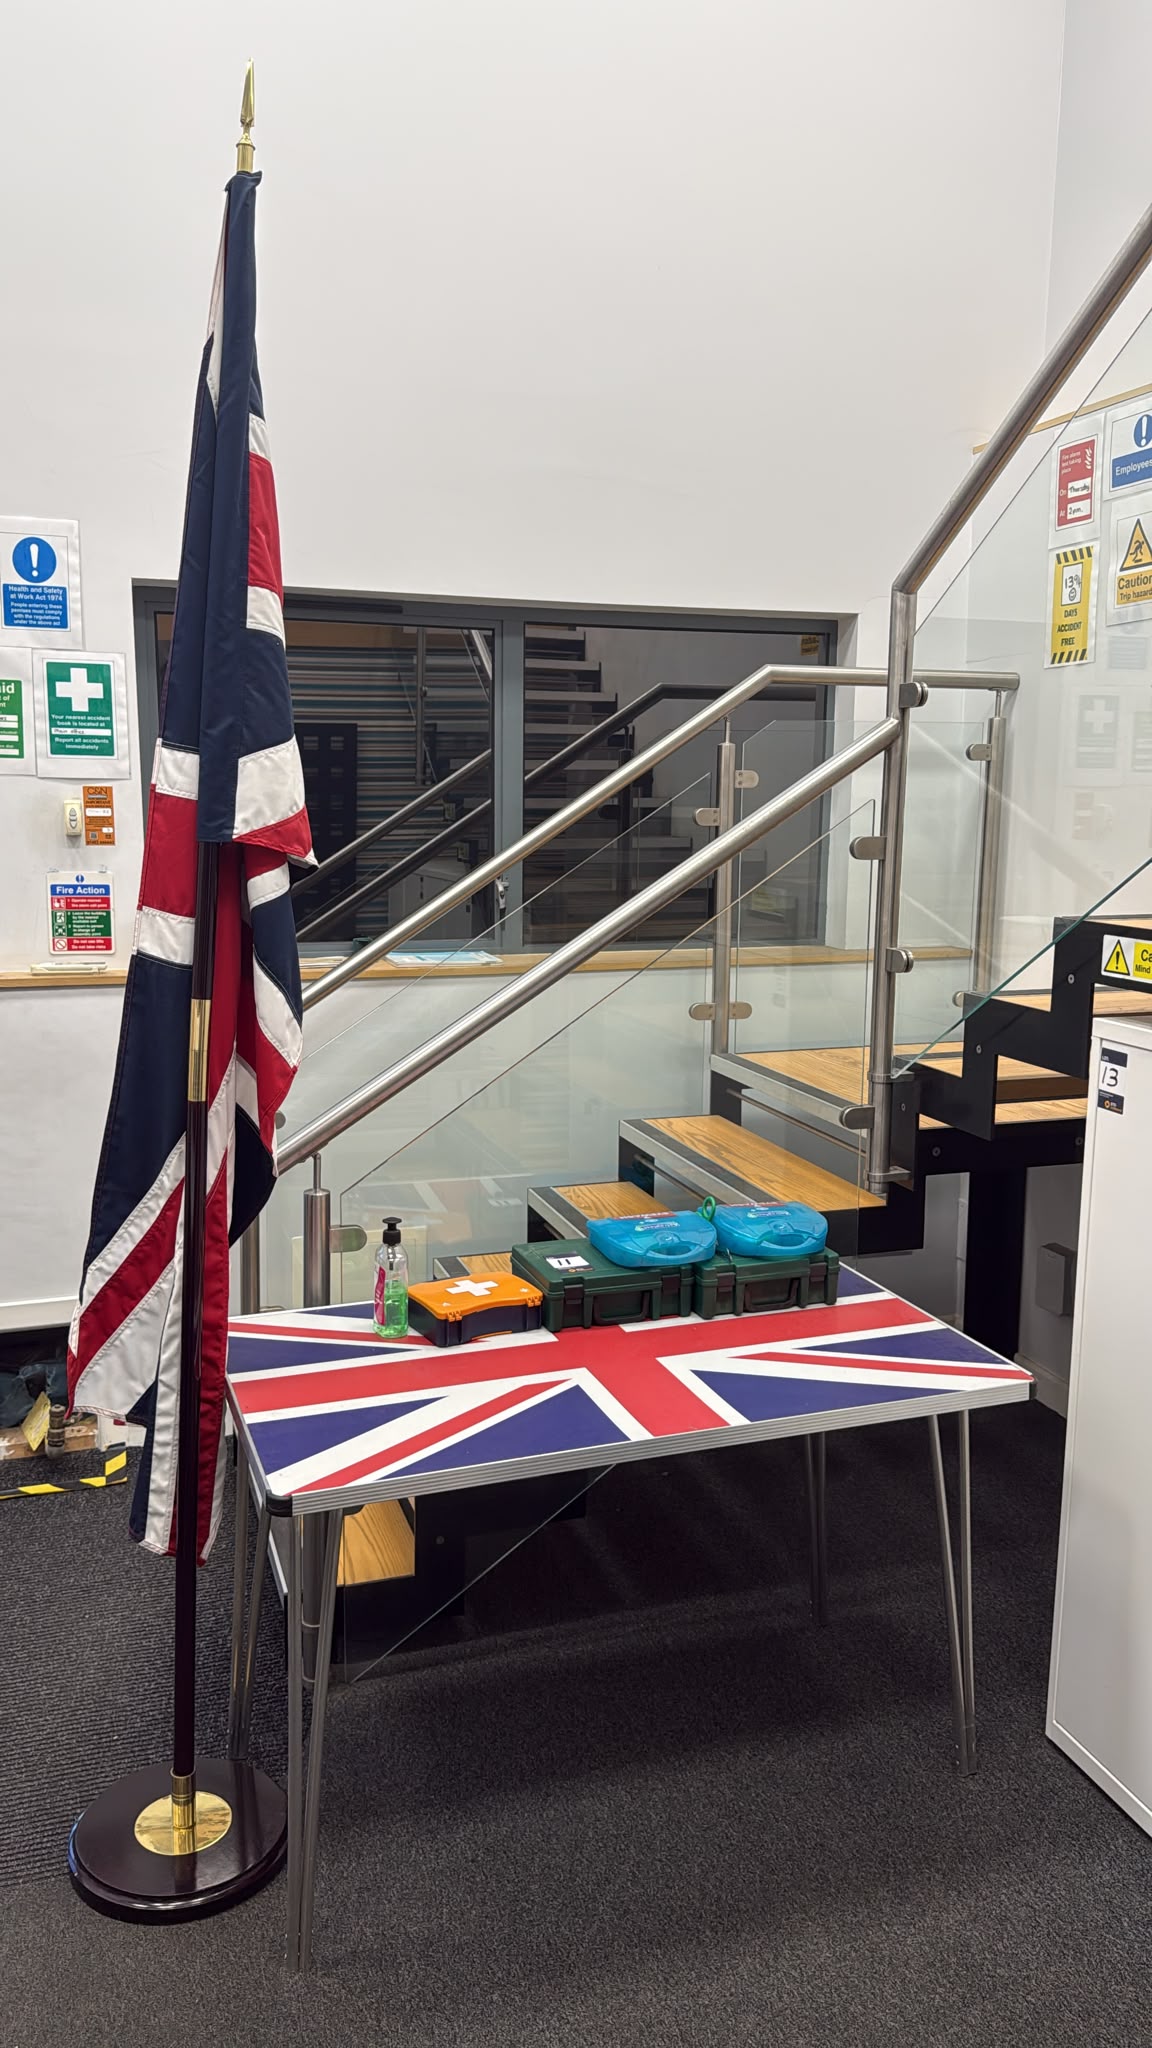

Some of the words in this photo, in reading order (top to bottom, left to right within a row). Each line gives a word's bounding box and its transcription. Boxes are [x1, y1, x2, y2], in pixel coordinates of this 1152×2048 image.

[43, 587, 63, 595] Safety
[1120, 592, 1131, 601] Trip
[1064, 608, 1077, 618] DAYS
[1057, 621, 1082, 633] ACCIDENT
[1061, 637, 1075, 646] FREE
[0, 682, 15, 693] id
[56, 886, 74, 894] Fire
[76, 886, 105, 894] Action
[1141, 949, 1152, 962] Ca
[1135, 964, 1150, 974] Mind
[1102, 1066, 1118, 1087] 13
